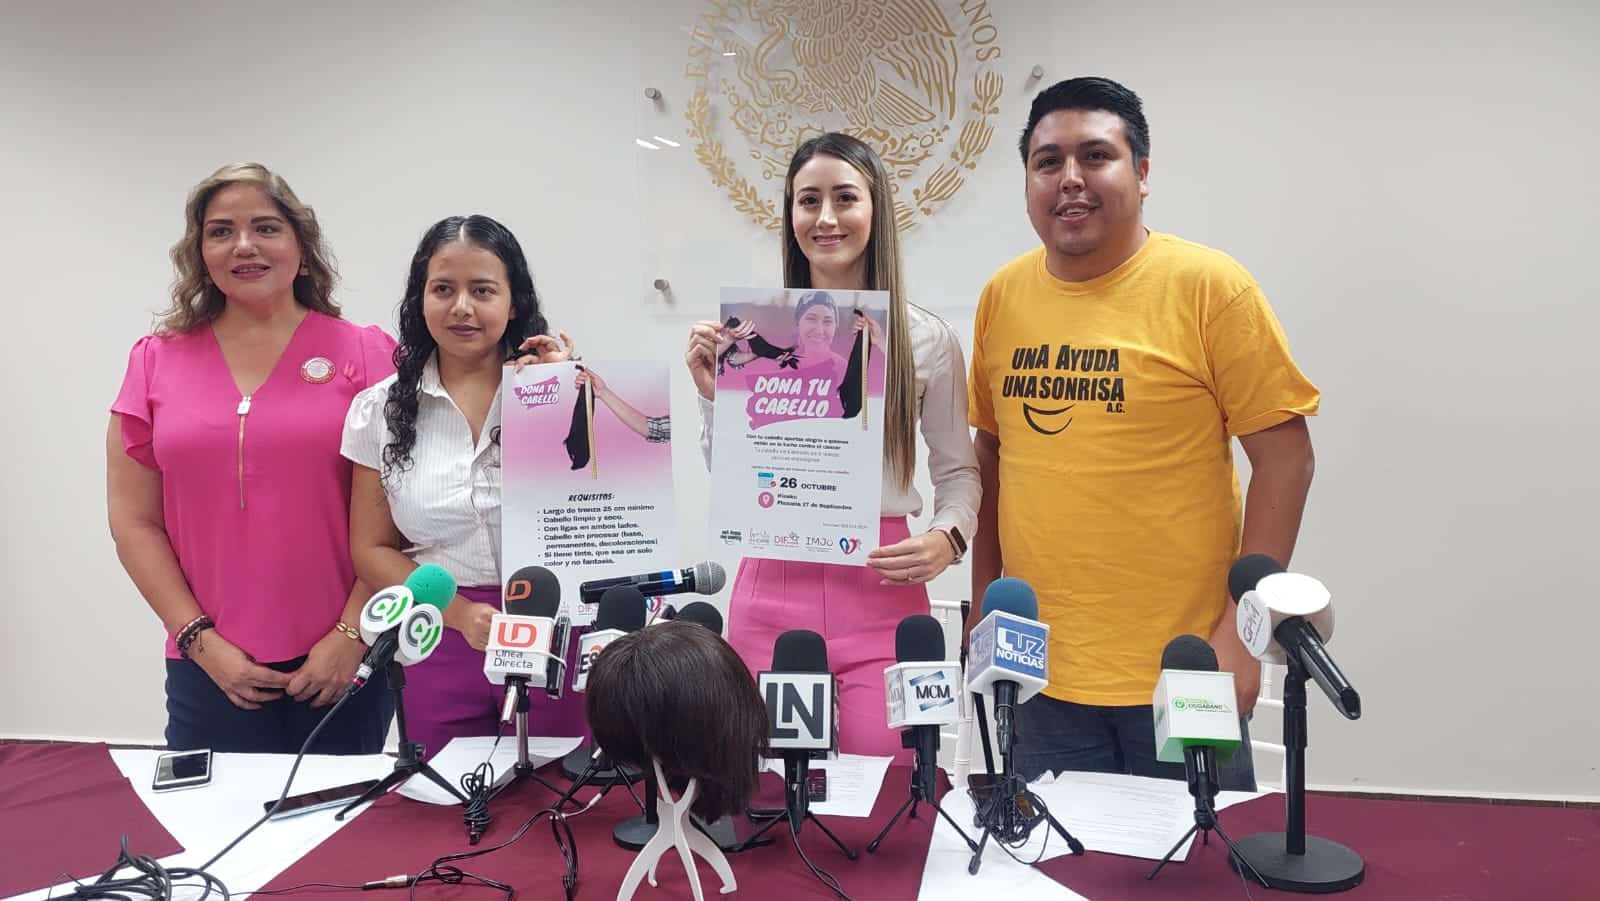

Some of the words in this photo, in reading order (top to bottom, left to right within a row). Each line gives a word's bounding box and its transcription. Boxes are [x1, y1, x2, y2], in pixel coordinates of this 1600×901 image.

[960, 0, 1001, 61] NOS
[1011, 344, 1050, 370] UNA
[1055, 344, 1120, 372] AYUDA
[521, 384, 545, 395] DONA
[547, 383, 560, 394] TU
[754, 375, 803, 396] DONA
[807, 378, 832, 397] TU
[521, 394, 560, 405] CABELLO
[754, 397, 830, 418] CABELLO
[779, 477, 798, 489] 26
[800, 483, 837, 491] OCTUBRE
[567, 492, 615, 502] REQUISITOS:
[543, 508, 565, 516] Largo
[573, 515, 597, 523] limpio
[560, 524, 578, 532] ligas
[586, 532, 619, 540] procesar
[545, 541, 598, 550] permanentes,
[996, 626, 1046, 660] LUZ
[493, 657, 534, 669] Directa
[996, 647, 1045, 670] NOTICIAS
[915, 684, 951, 700] MCM
